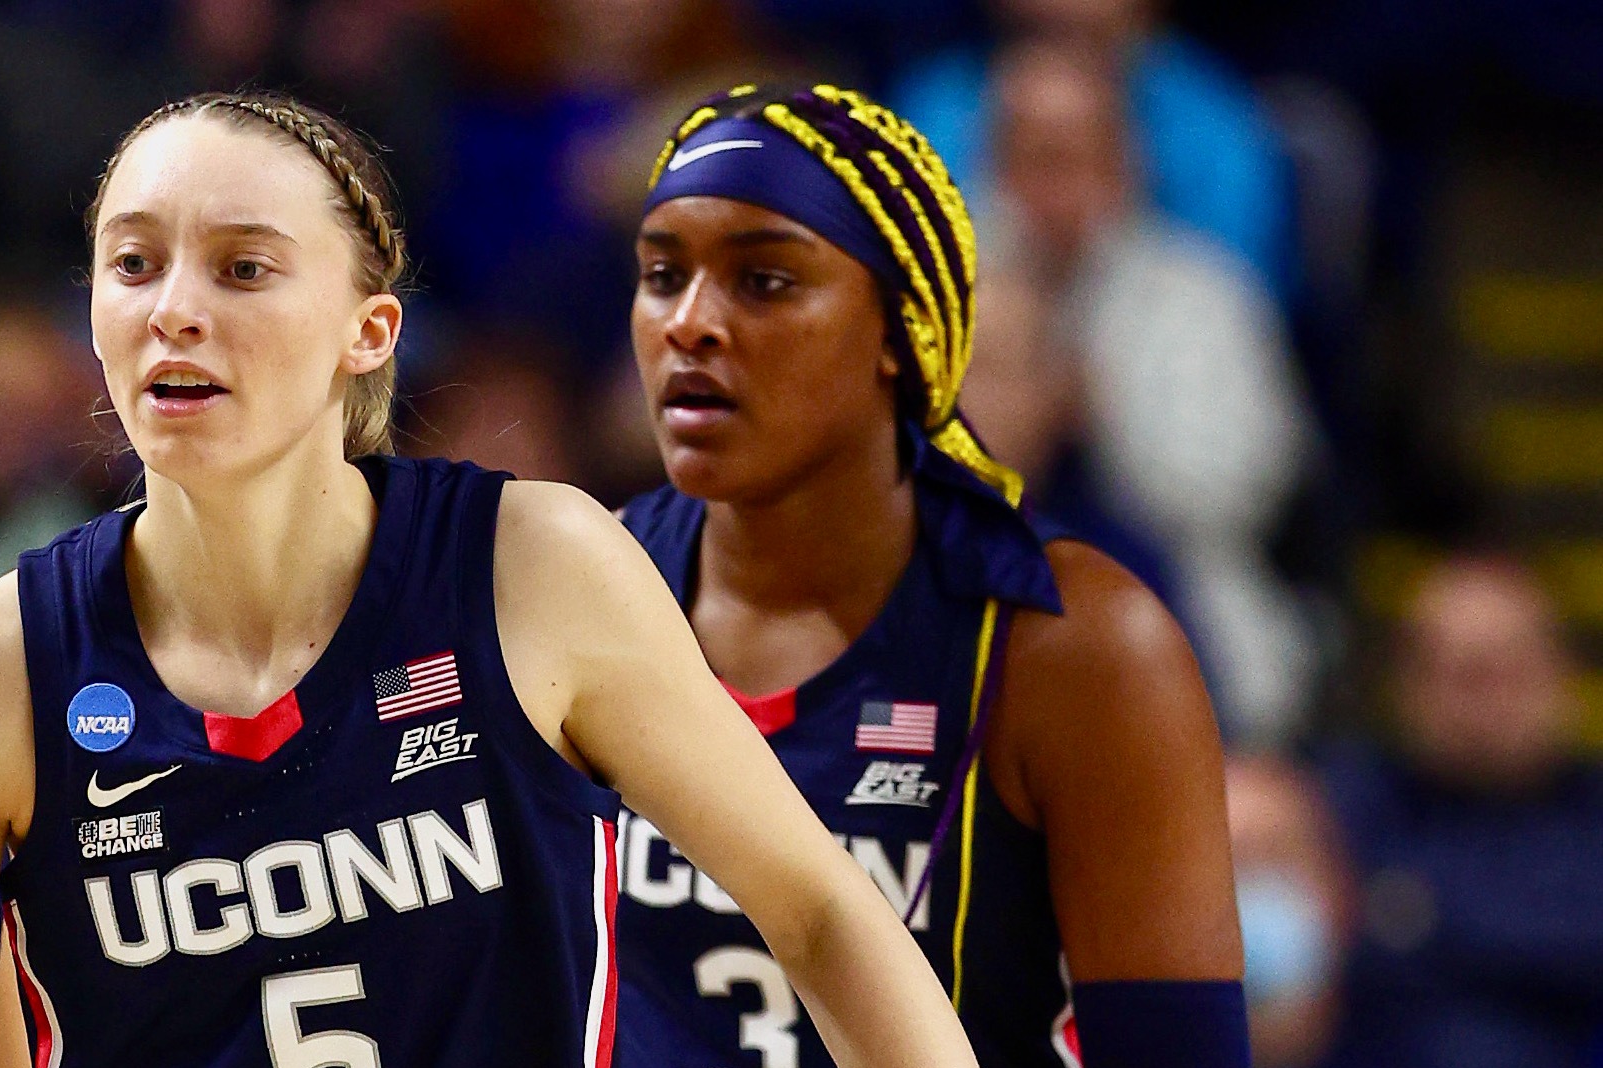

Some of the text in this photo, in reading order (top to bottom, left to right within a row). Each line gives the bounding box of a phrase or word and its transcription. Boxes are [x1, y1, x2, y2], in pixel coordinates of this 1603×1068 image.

[76, 716, 130, 735] NCAA
[400, 717, 459, 751] BIG
[395, 733, 479, 771] EAST
[81, 832, 164, 859] CHANGE
[84, 798, 504, 967] UCONN
